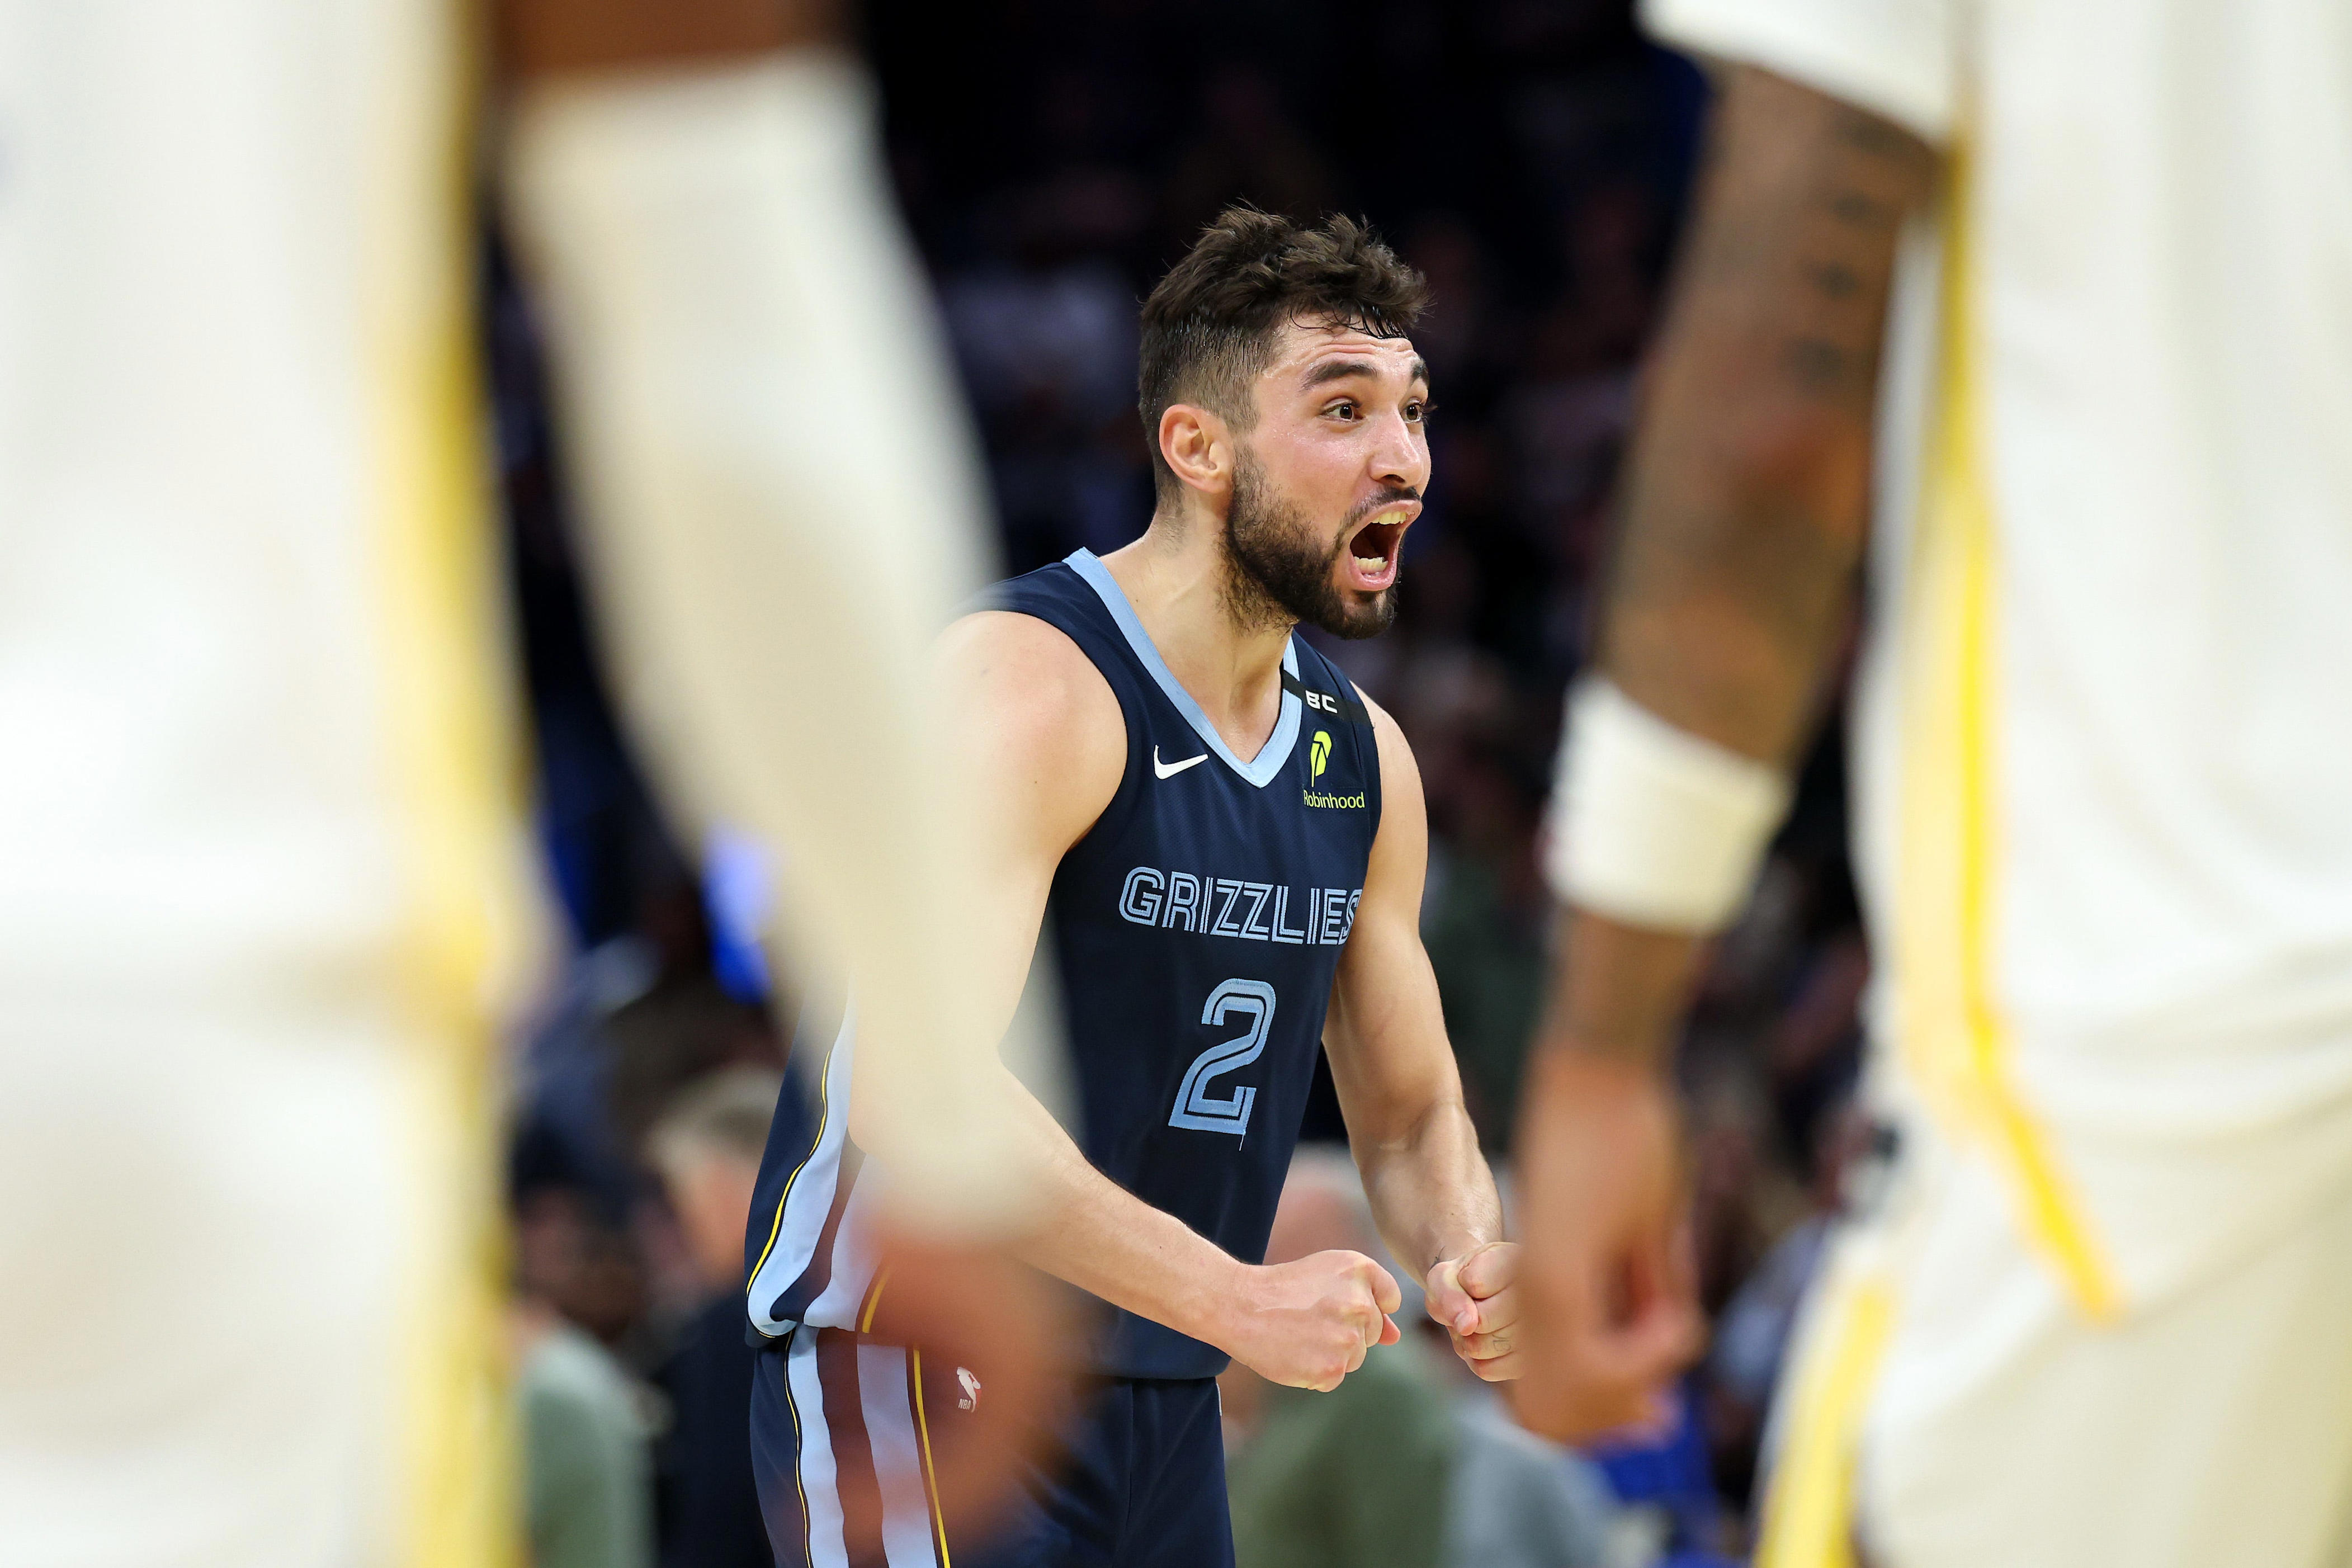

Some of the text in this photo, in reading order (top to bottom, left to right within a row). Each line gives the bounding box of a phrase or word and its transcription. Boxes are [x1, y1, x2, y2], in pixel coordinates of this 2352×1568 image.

[1305, 689, 1338, 714] BC
[1303, 790, 1365, 809] Robinhood
[1119, 866, 1362, 945] GRIZZLIES
[1168, 978, 1276, 1136] 2
[958, 1398, 971, 1410] NBA
